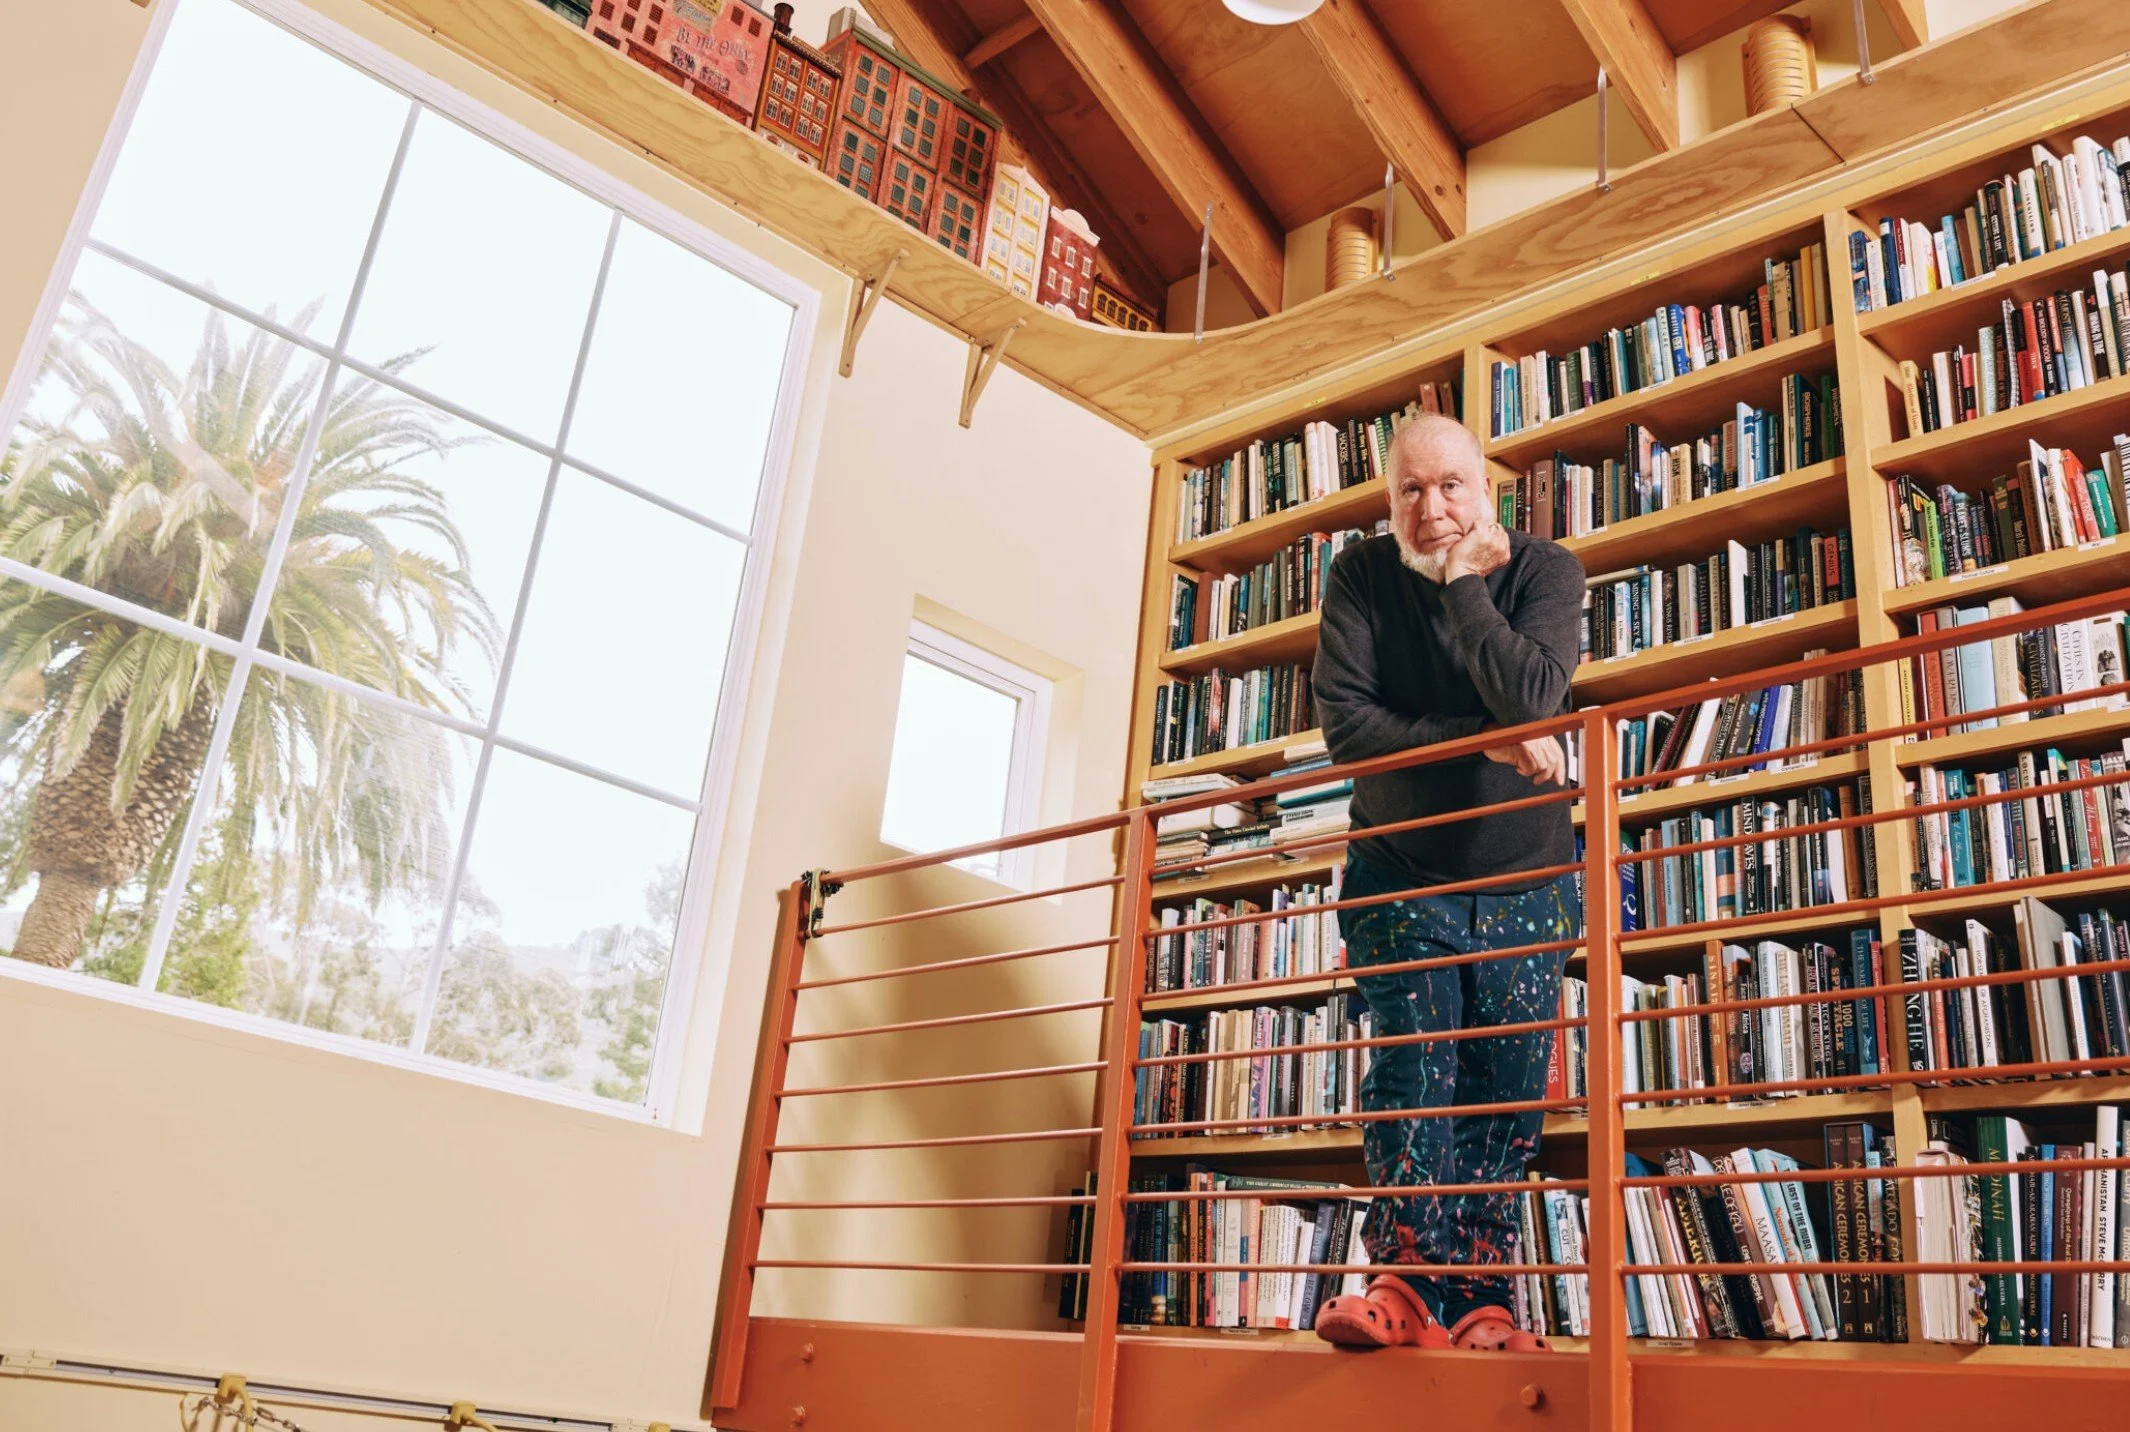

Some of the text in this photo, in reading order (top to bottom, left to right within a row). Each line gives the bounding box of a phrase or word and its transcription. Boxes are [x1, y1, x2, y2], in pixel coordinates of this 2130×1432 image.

[1660, 310, 1669, 348] RAPTURE
[2039, 318, 2047, 339] BIOLOGY
[2042, 345, 2051, 363] DOOM
[1803, 392, 1812, 438] BIOSPHERES
[1339, 432, 1347, 464] HACKERS
[1672, 458, 1680, 477] RISK
[1955, 502, 1967, 529] PLANET
[1826, 544, 1836, 577] GENIUS
[1959, 533, 1970, 557] SLUMS
[2060, 624, 2074, 692] CIVILIZATION
[2071, 630, 2083, 664] CITIES
[2029, 643, 2042, 714] CIVILIZATIOS
[1742, 803, 1755, 870] MINDAVES
[1865, 810, 1873, 847] ARICAN
[2116, 926, 2126, 952] Burmese
[1856, 945, 1869, 1029] THE VARIE OF LIFE
[1902, 952, 1925, 1051] ZHNG HE
[1741, 1013, 1749, 1034] Africa
[1830, 966, 1844, 1051] SPETACLE
[1842, 1003, 1853, 1027] 1000
[1981, 1000, 1992, 1048] AFGHANISTAN
[1787, 1184, 1799, 1202] LAST
[1988, 1147, 2005, 1222] MDINAH
[1561, 1228, 1569, 1246] CUT
[1774, 1206, 1789, 1247] Nomads
[1795, 1213, 1805, 1227] THE
[1754, 1216, 1780, 1265] MAASA
[1798, 1228, 1812, 1250] NUBA
[2097, 1216, 2106, 1292] STEVE McCRRY
[1835, 1214, 1851, 1304] CEREMONES 2
[1856, 1212, 1870, 1304] CEREMONES 1
[1998, 1279, 2006, 1306] SILVEIRA
